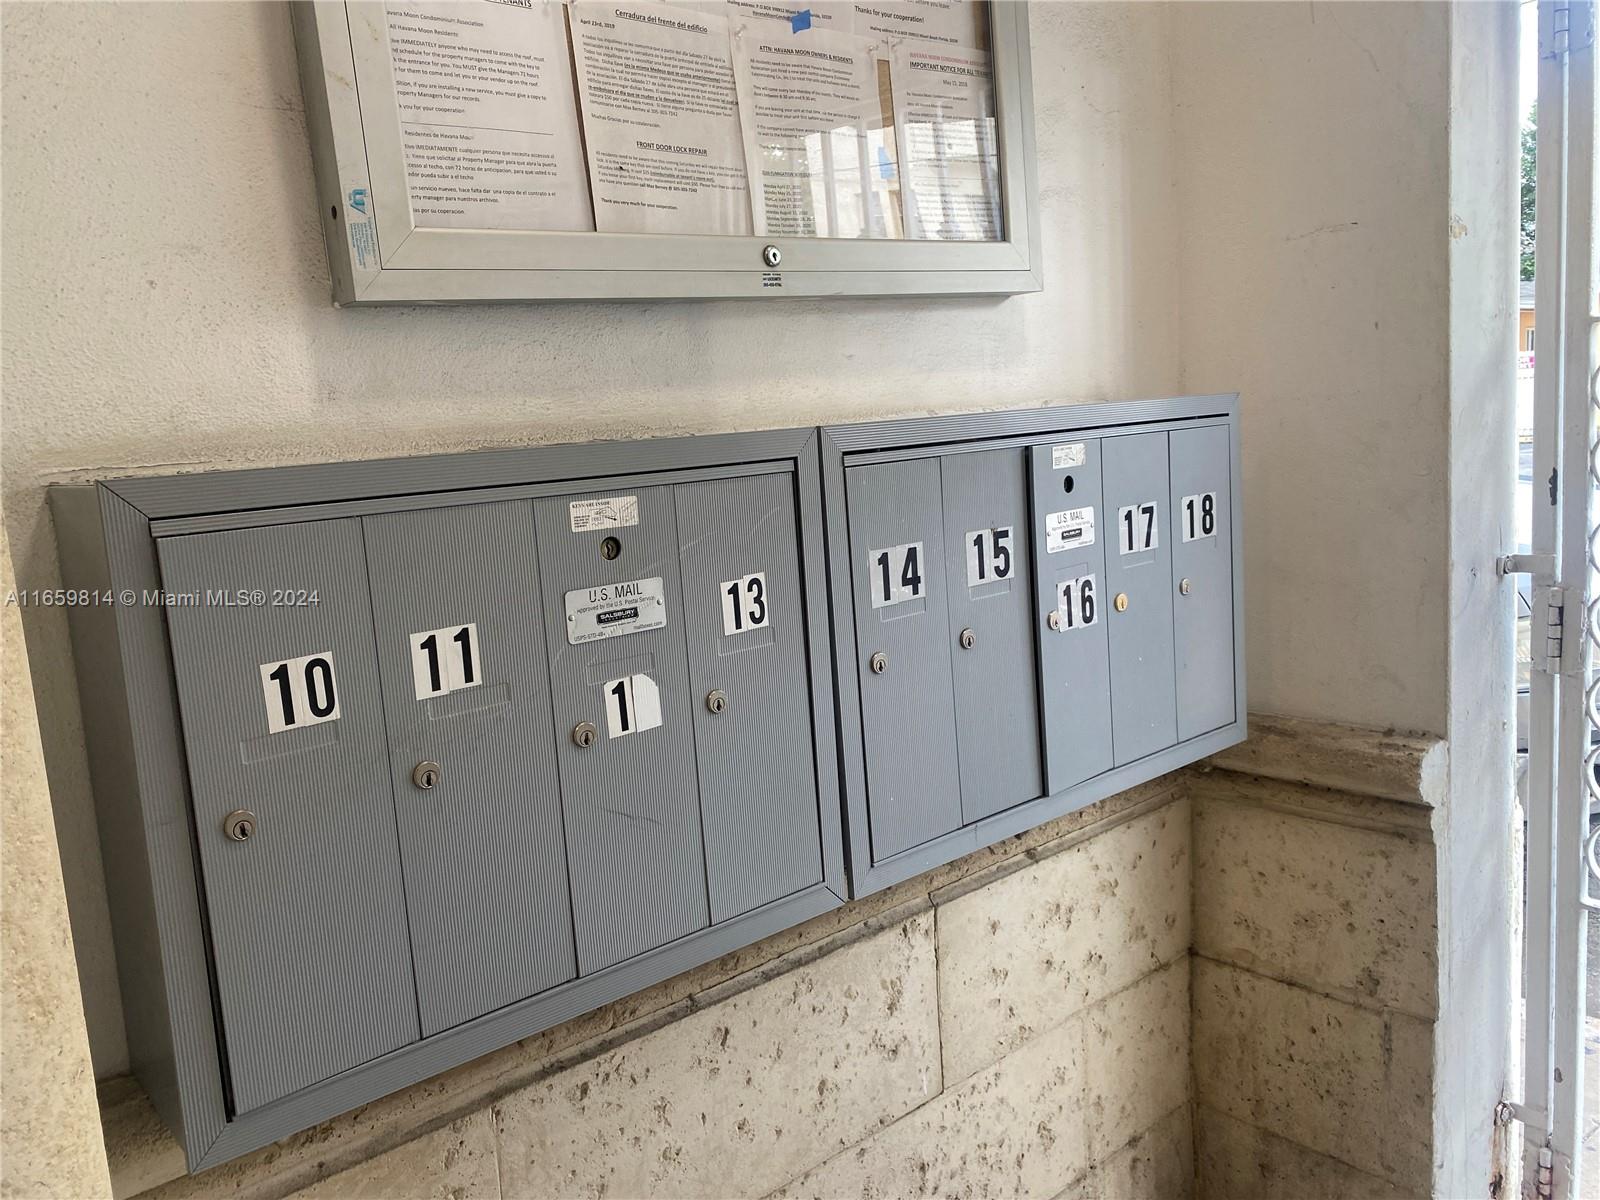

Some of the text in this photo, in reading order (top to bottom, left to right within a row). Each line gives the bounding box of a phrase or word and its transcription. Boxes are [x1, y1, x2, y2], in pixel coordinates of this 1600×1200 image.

[615, 8, 708, 33] Cerradura del frente del edificio
[854, 5, 925, 24] Thanks for your cooperation!
[400, 38, 437, 49] IMMEDIATELY
[773, 46, 794, 56] HAVANA
[794, 49, 811, 57] MOON
[910, 60, 939, 71] IMPORTANT
[939, 64, 957, 74] NOTICE
[957, 66, 967, 75] FOR
[636, 140, 708, 156] FRONT DOOR LOCK REPAIR
[1069, 510, 1085, 521] MAIL
[1124, 505, 1154, 551] 17
[1186, 494, 1214, 539] 18
[973, 529, 1010, 580] 15
[877, 546, 921, 602] 14
[588, 582, 643, 603] U.S. MAIL
[727, 577, 766, 631] 13
[1063, 579, 1095, 627] 16
[600, 609, 635, 619] SALSBURY
[420, 627, 474, 693] 11
[270, 657, 336, 726] 10
[611, 680, 630, 732] 1
